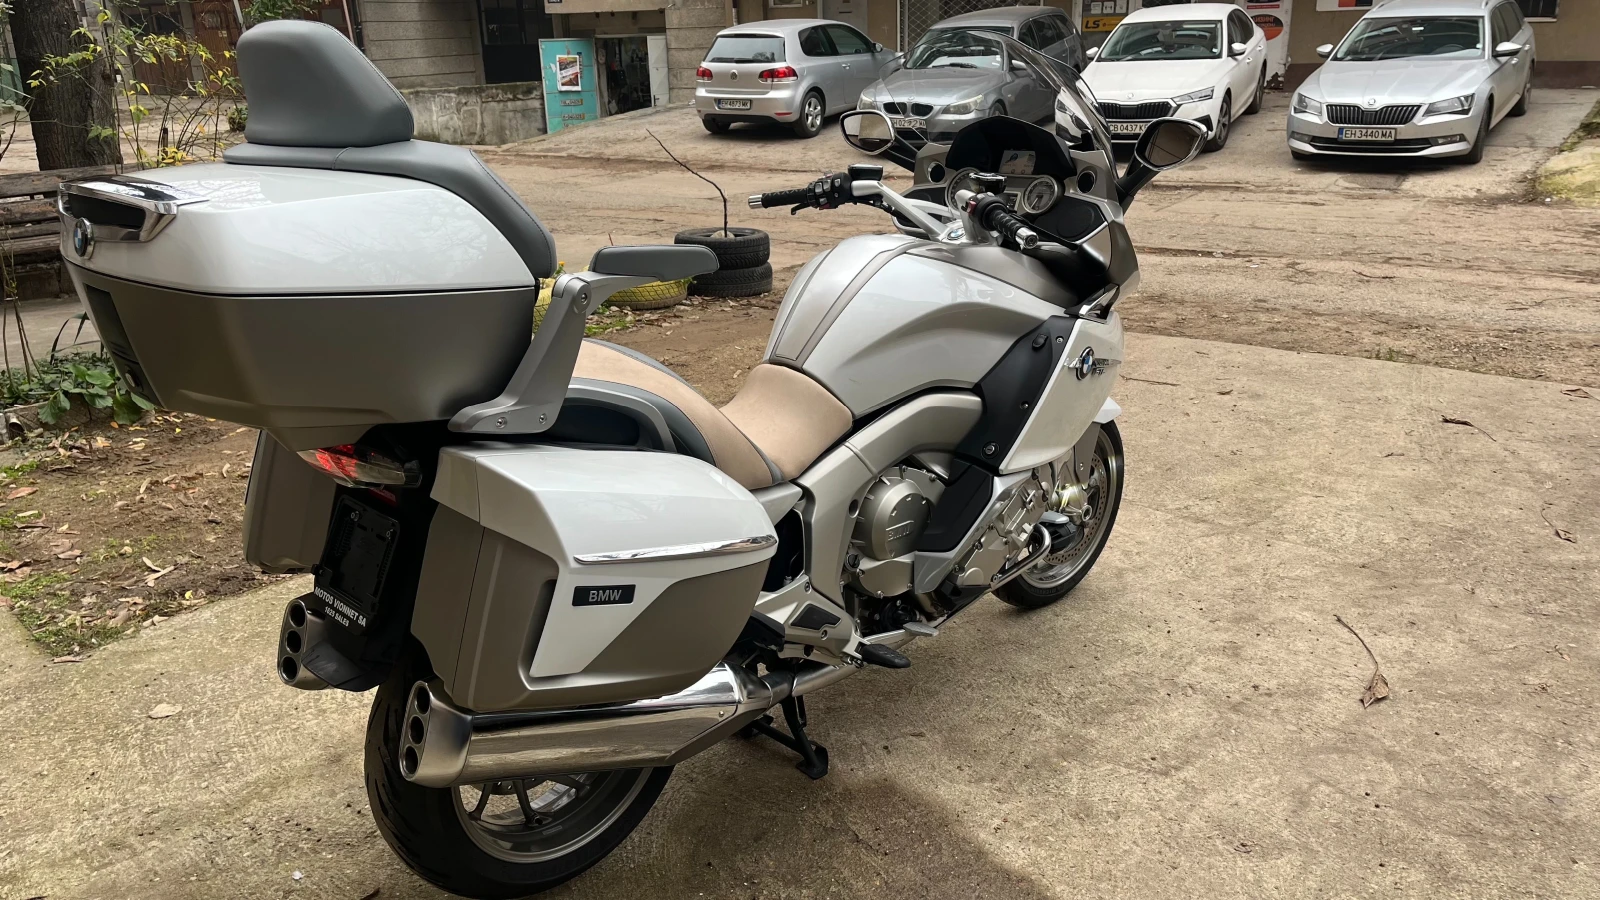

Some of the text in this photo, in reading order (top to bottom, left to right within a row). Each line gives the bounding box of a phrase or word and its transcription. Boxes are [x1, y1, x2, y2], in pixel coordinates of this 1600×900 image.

[1085, 20, 1100, 29] LS
[1120, 124, 1138, 132] 0437
[1345, 130, 1393, 139] EH 3440 MA
[589, 589, 622, 602] BMW
[314, 586, 367, 627] MOTOS VIONNET SA
